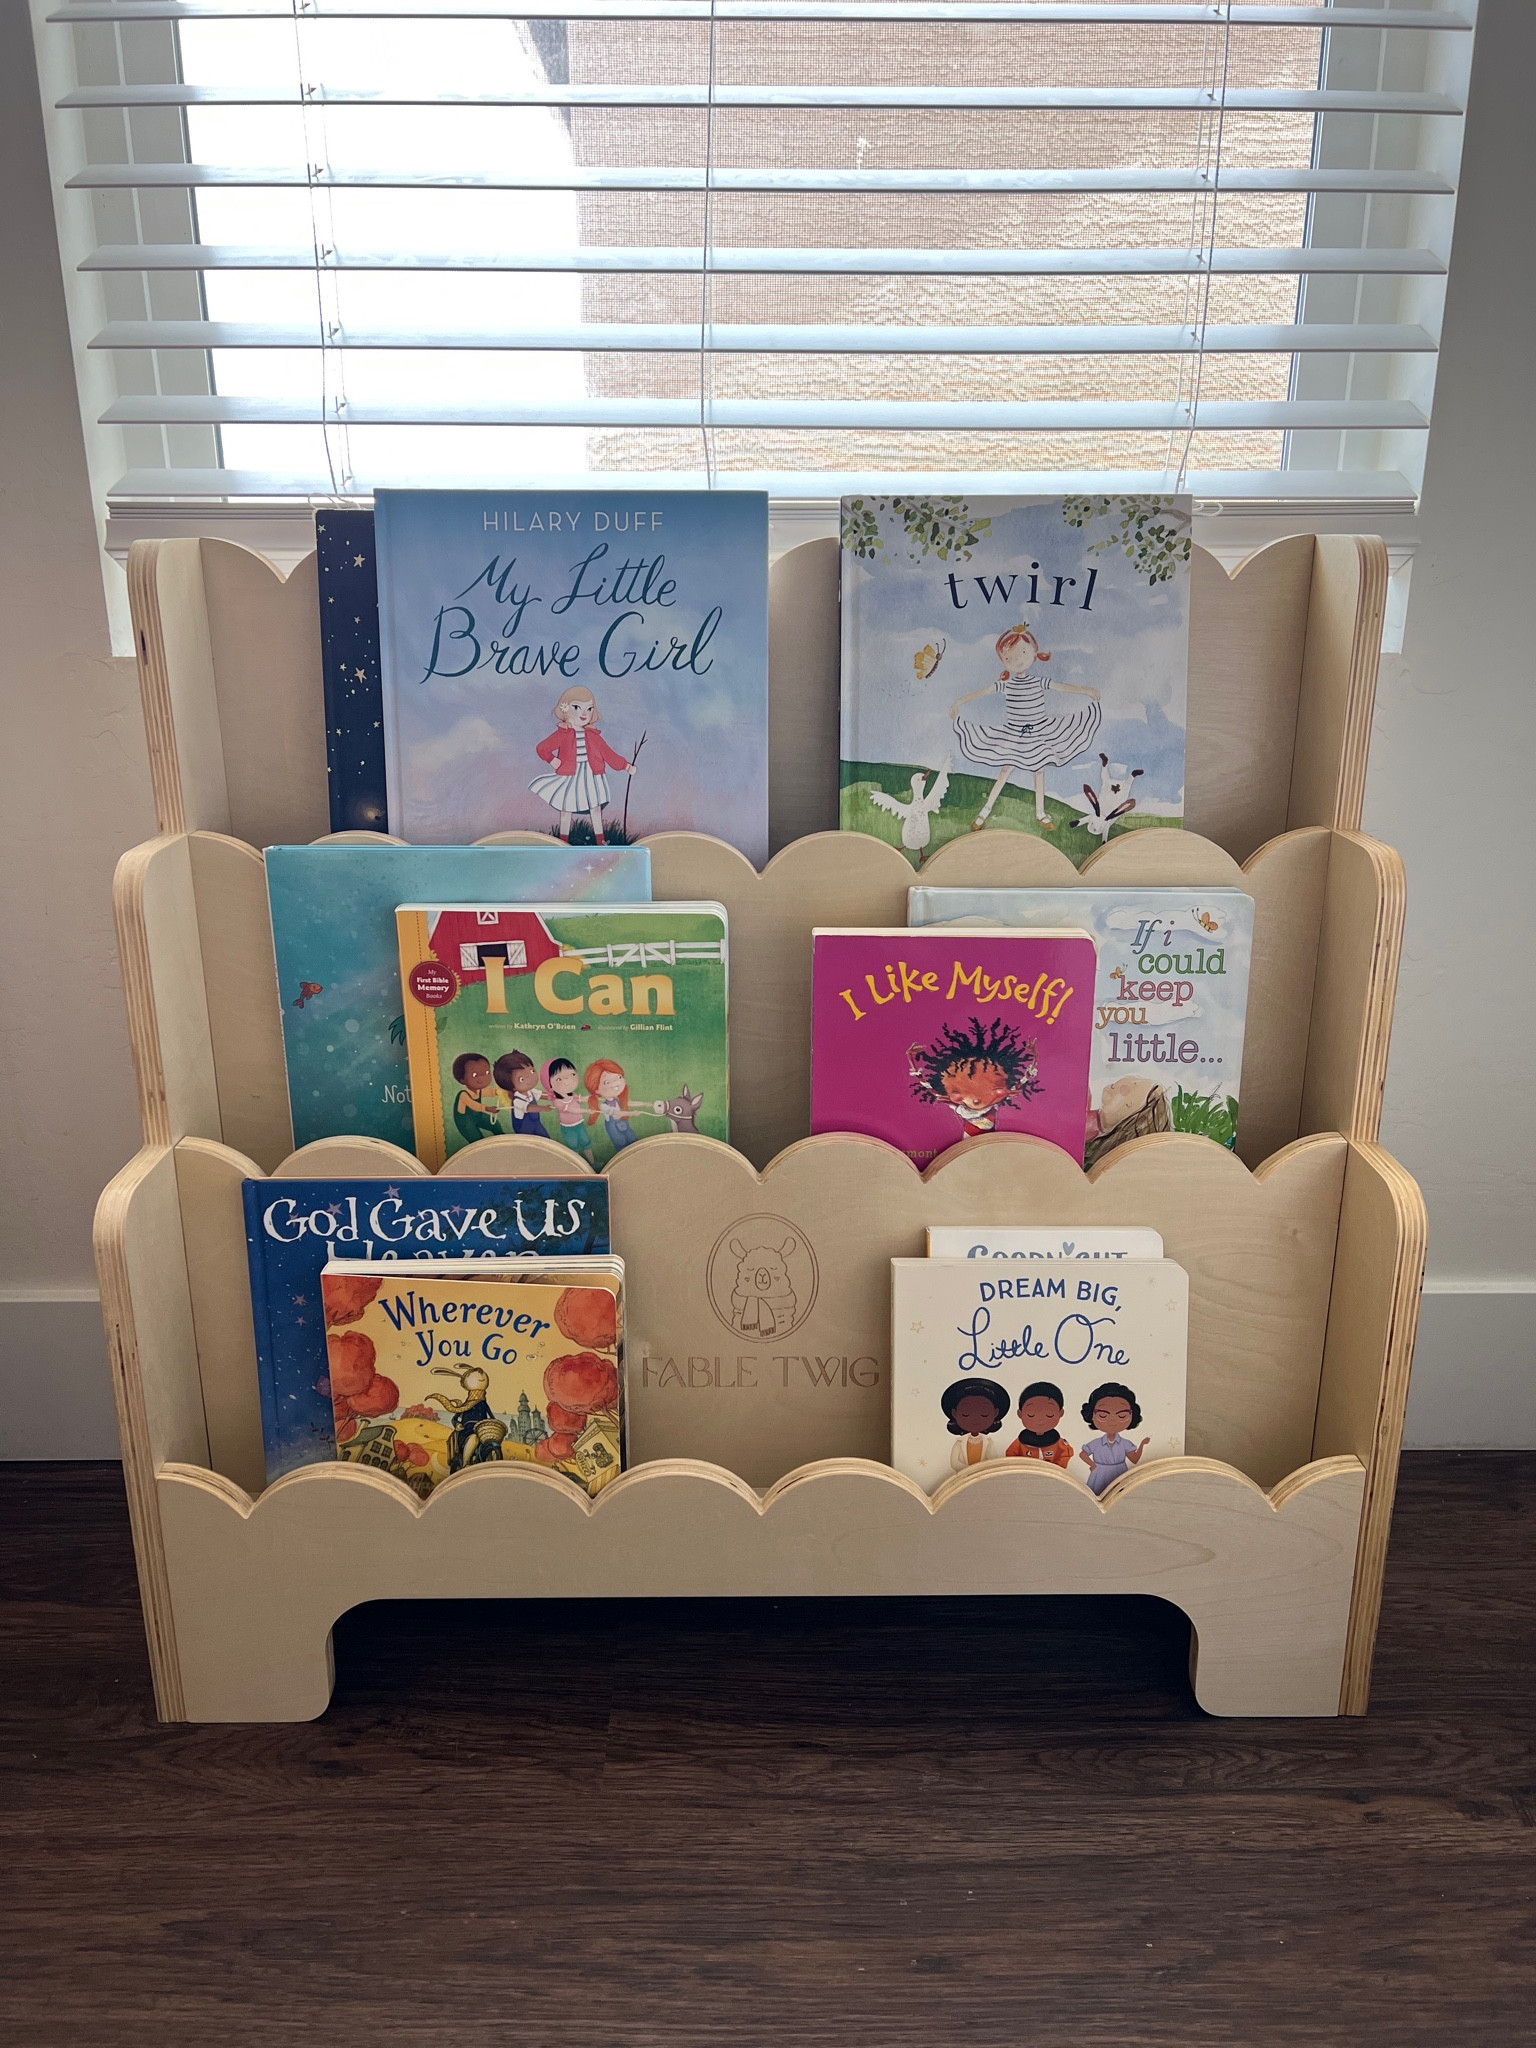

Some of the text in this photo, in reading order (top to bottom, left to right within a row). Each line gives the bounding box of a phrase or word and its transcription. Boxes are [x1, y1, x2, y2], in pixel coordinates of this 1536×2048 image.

[483, 511, 665, 532] HILARY DUFF
[453, 542, 678, 638] My Little
[943, 561, 1098, 612] twirl
[418, 604, 724, 685] Brave Girl
[1130, 919, 1173, 957] If i
[1138, 948, 1227, 975] could
[417, 984, 450, 992] Memory
[481, 955, 676, 1017] I Can
[839, 960, 1075, 1026] I Like Myself!
[1116, 975, 1195, 1007] keep
[513, 1022, 546, 1031] Kathryn
[547, 1022, 577, 1030] O'Brien
[630, 1023, 654, 1031] Gillian
[1095, 1004, 1148, 1030] you
[1108, 1032, 1223, 1065] little...
[263, 1197, 586, 1243] God Gave Us
[978, 1277, 1123, 1313] DREAM BIG,
[378, 1290, 551, 1340] Wherever
[415, 1331, 518, 1368] You Go
[957, 1307, 1131, 1371] Little One
[642, 1356, 881, 1388] FABLE TWIG
